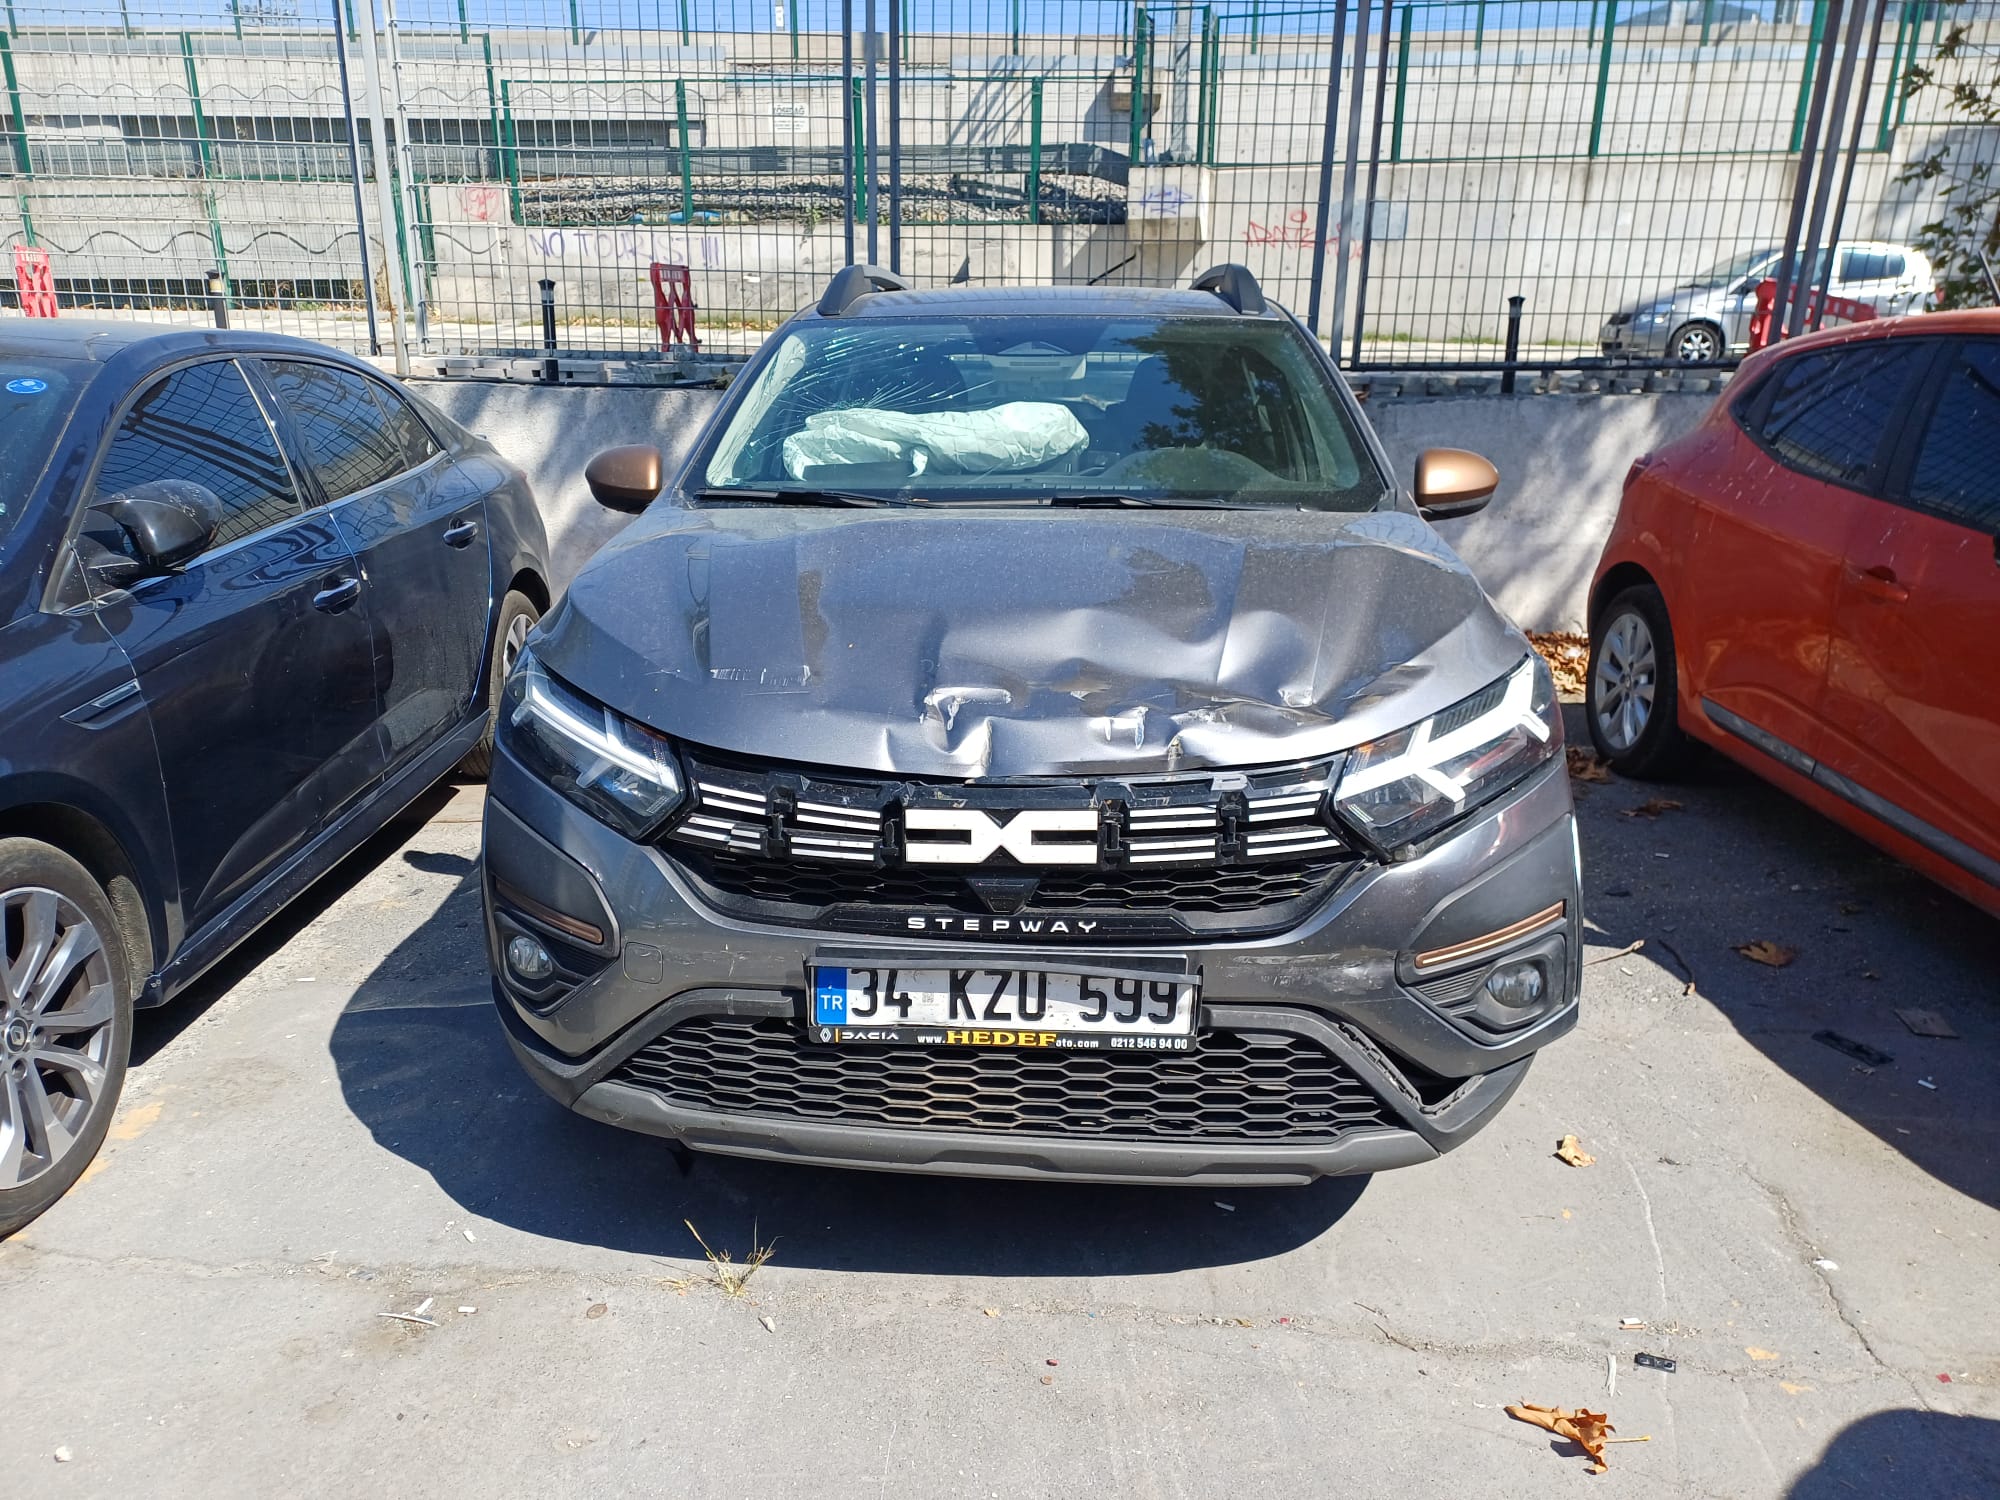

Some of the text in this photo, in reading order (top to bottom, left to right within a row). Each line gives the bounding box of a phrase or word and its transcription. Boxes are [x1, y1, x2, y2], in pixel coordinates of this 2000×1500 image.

[529, 230, 565, 259] NO
[907, 917, 1097, 933] STEPWAY
[820, 994, 843, 1010] TR
[851, 968, 1178, 1025] 34 KZU 599
[841, 1031, 899, 1041] DACIA
[1110, 1037, 1187, 1050] 0212 546 94 00
